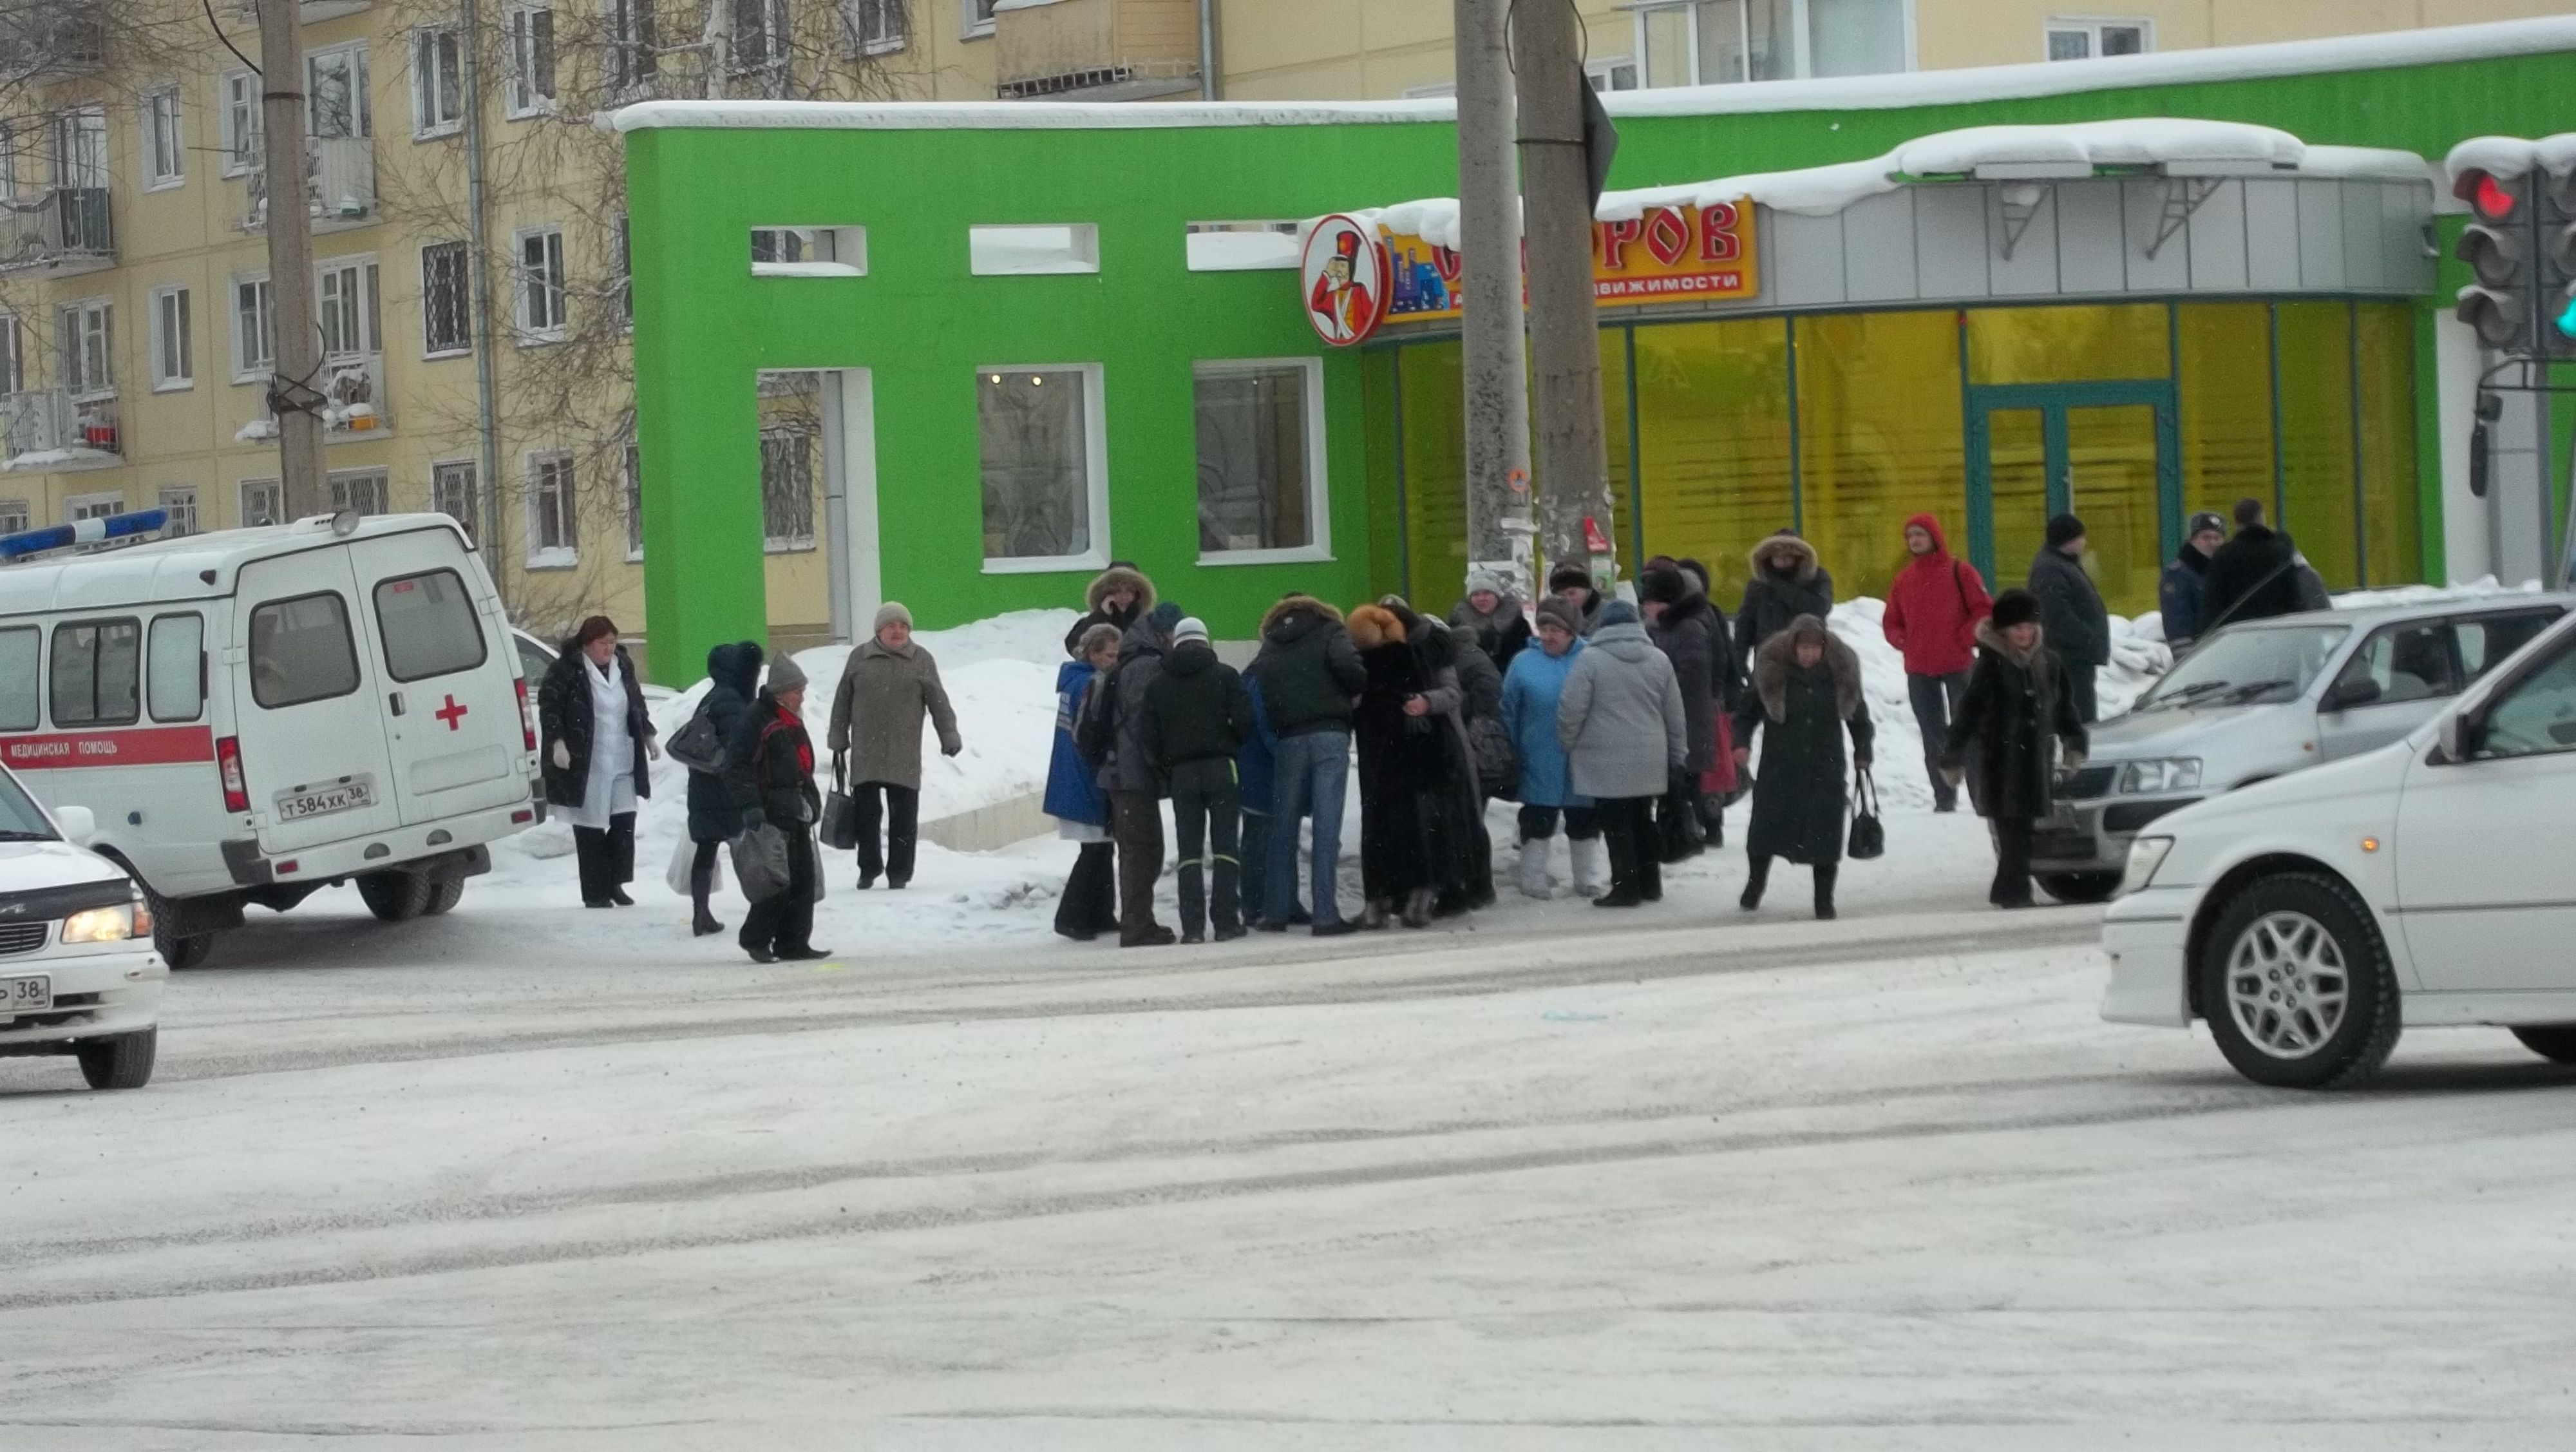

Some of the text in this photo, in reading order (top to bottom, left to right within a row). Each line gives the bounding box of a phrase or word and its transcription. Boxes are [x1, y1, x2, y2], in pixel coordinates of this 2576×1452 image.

[1595, 274, 1738, 295] ВИЖИМОСТИ
[11, 742, 70, 758] МЕДИЦИНСКАЯ
[79, 740, 117, 755] ПОМОЩЬ
[348, 787, 364, 800] 38
[17, 981, 39, 998] 38
